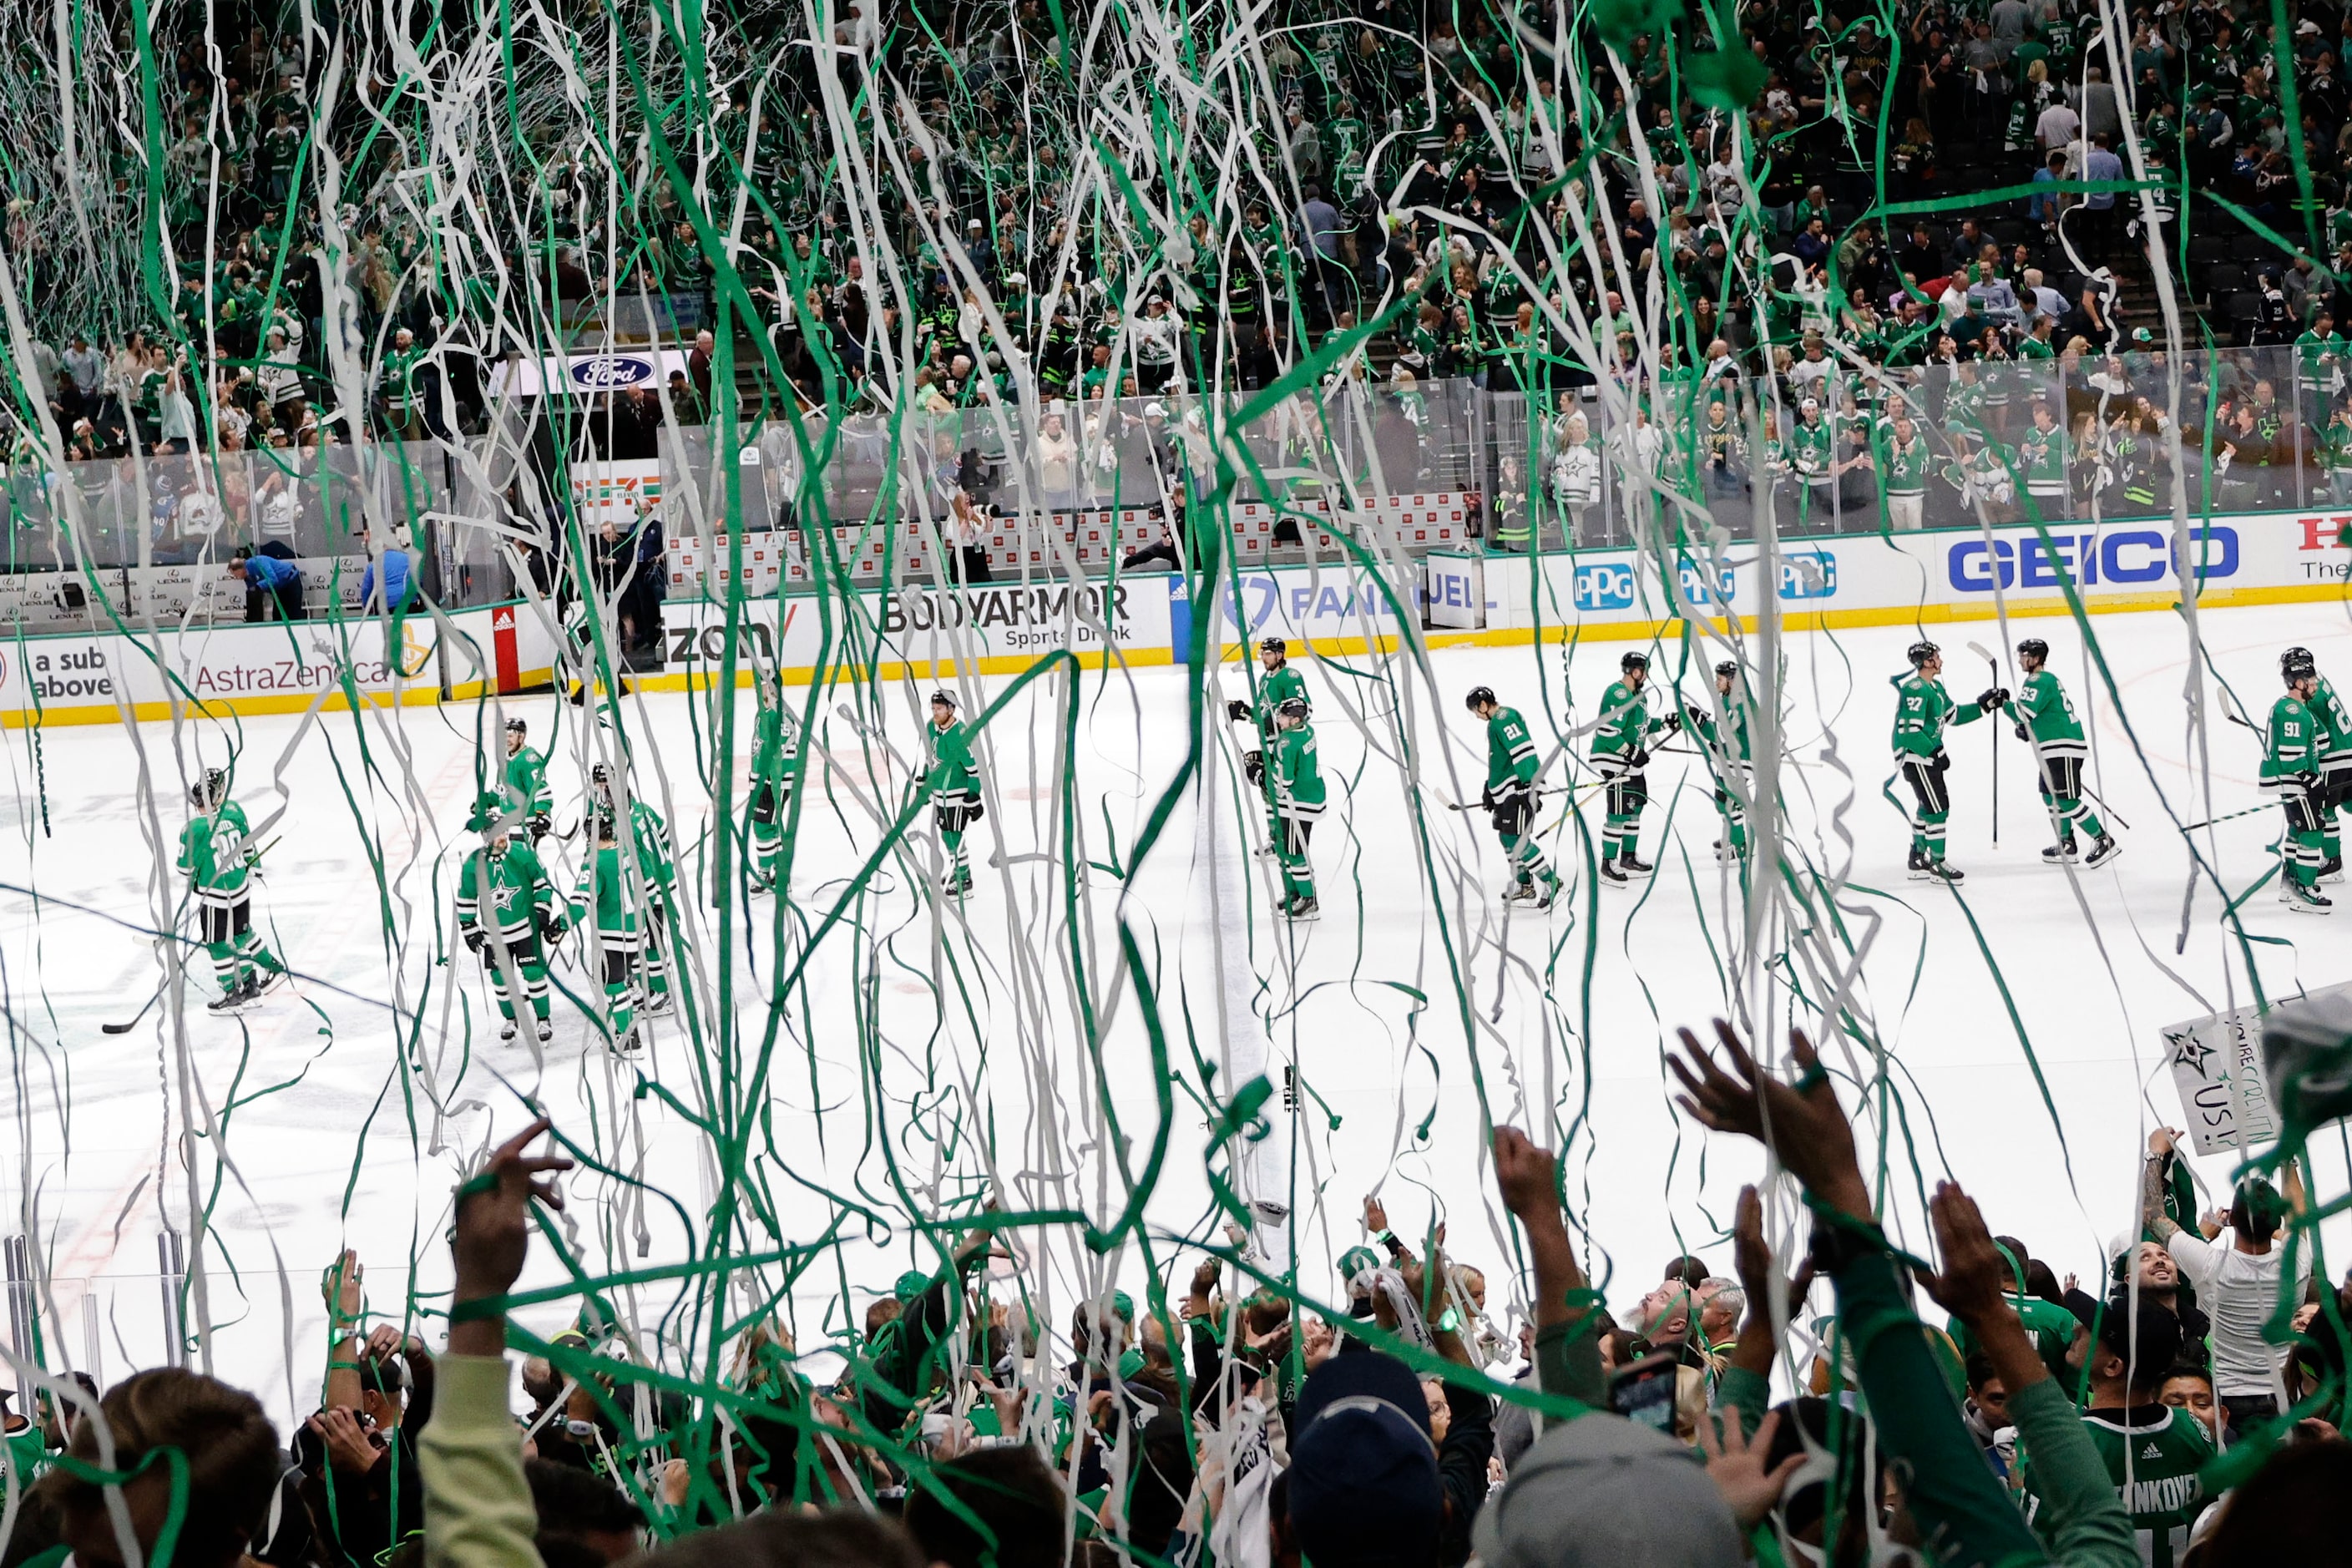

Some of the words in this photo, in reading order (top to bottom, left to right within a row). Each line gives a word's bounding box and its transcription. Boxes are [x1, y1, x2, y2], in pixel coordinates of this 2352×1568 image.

[584, 362, 637, 385] Ford
[1947, 526, 2239, 592] GEICO
[2300, 561, 2349, 579] The
[1576, 567, 1632, 608] PPG
[879, 584, 1130, 633] BODYARMOR
[1077, 625, 1130, 642] Drnk
[36, 655, 50, 671] a
[60, 646, 106, 670] sub
[35, 674, 113, 698] above
[1503, 722, 1523, 741] 21
[2284, 721, 2301, 737] 91
